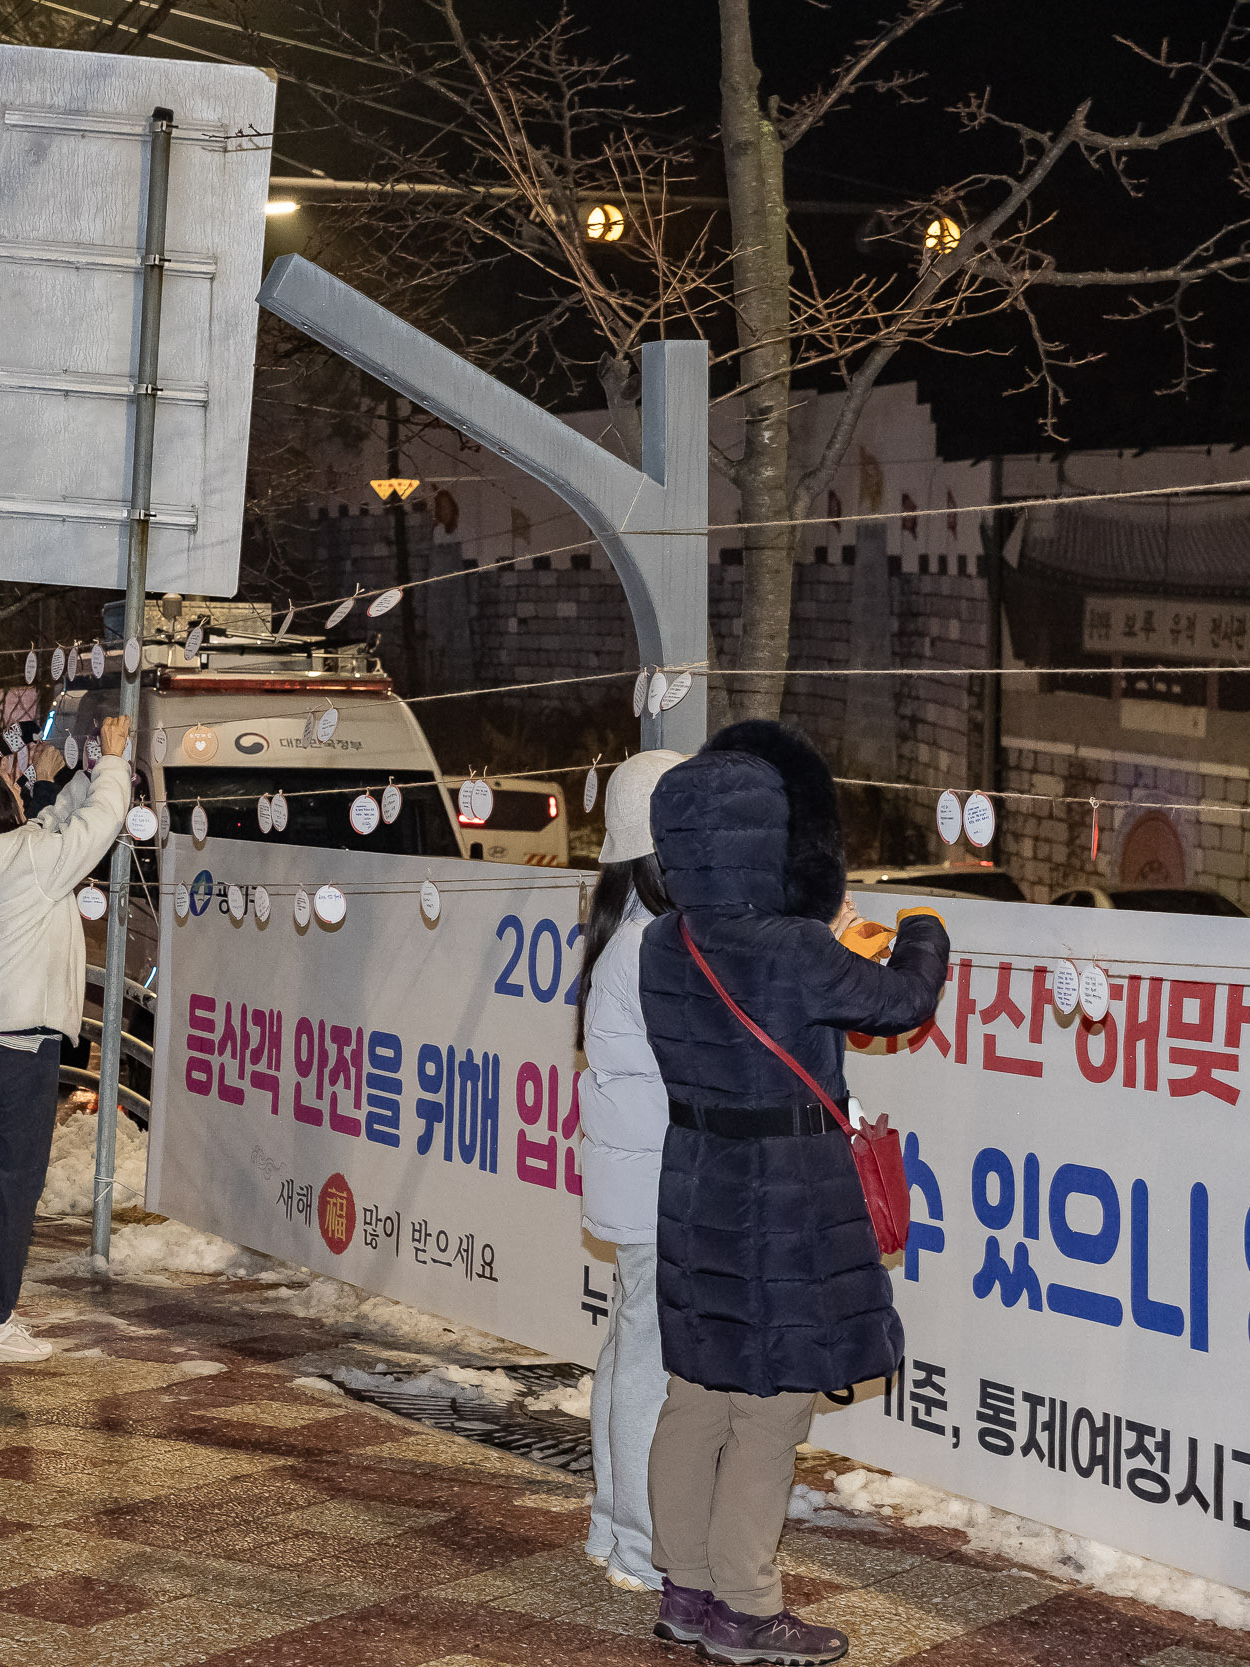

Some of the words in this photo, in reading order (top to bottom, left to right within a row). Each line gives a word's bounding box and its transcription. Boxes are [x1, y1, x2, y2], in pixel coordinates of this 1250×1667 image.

[186, 994, 282, 1116] 등산객
[293, 1016, 402, 1149] 안전을
[415, 1043, 500, 1174] 위해
[971, 1147, 1209, 1353] 있으니
[276, 1178, 313, 1228] 새해
[323, 1185, 348, 1242] 福
[361, 1204, 401, 1258] 많이
[409, 1218, 500, 1283] 받으세요
[581, 1265, 616, 1326] 누
